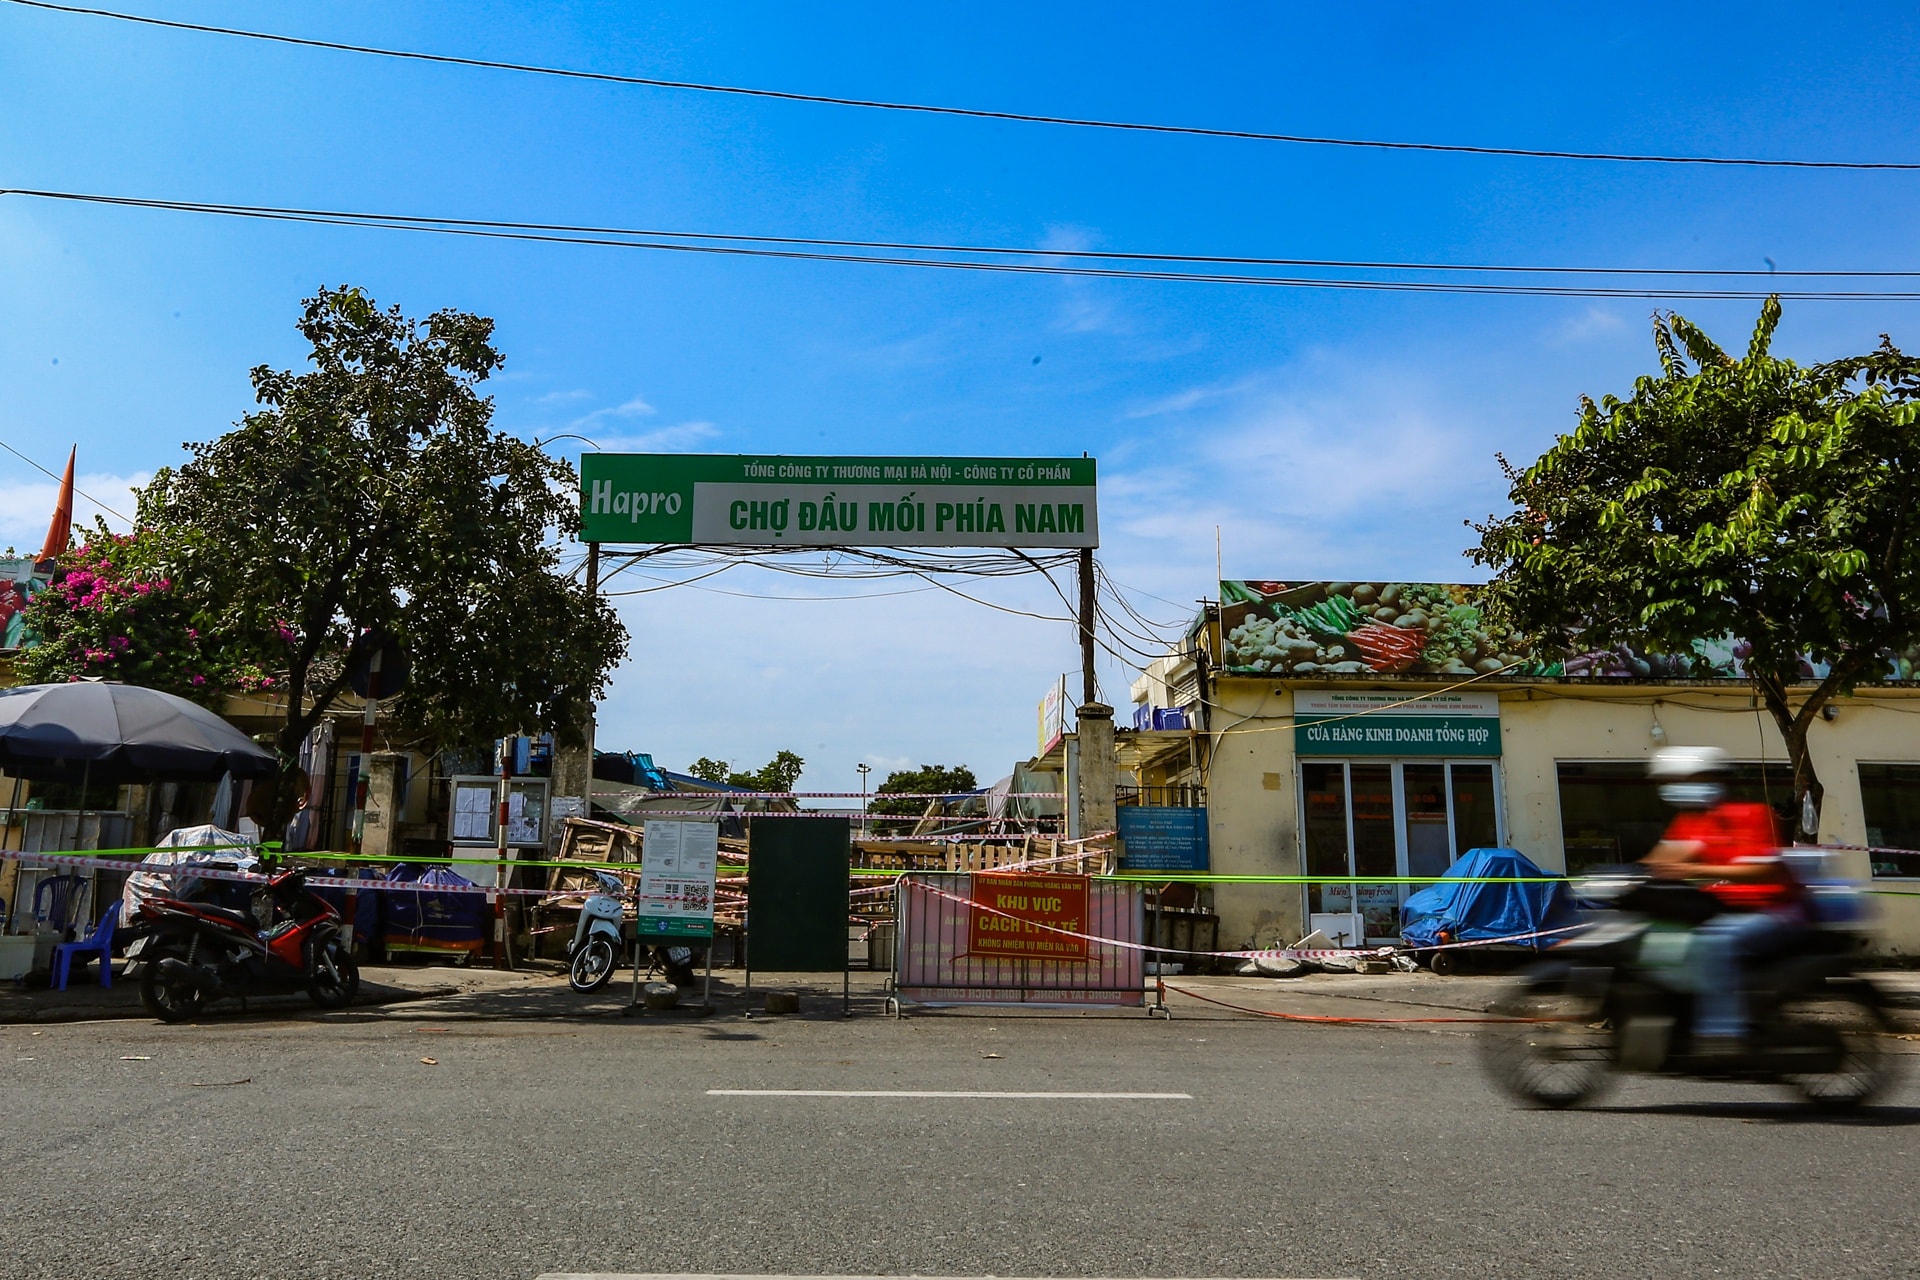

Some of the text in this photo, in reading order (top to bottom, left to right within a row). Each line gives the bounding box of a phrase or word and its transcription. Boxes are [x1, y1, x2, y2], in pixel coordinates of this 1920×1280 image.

[743, 459, 775, 478] TỔNG
[778, 462, 812, 478] CÔNG
[814, 465, 829, 478] TY
[832, 464, 881, 479] THƯƠNG
[884, 465, 907, 482] MẠI
[910, 464, 927, 480] HÀ
[930, 463, 952, 482] NỘI
[963, 463, 997, 480] CÔNG
[1000, 466, 1014, 480] TY
[1017, 462, 1035, 480] CỔ
[590, 479, 682, 523] Hapro
[729, 491, 1084, 537] CHỢ ĐẦU MỐI PHÍA NAM
[1307, 721, 1489, 746] CỬA HÀNG KINH DOANH TỔNG HỢP
[996, 894, 1062, 915] KHU VỰC
[979, 914, 1020, 933] CÁCH
[1060, 916, 1079, 934] TẾ
[978, 936, 1001, 948] KHÔNG
[1026, 940, 1036, 953] VỤ
[1055, 941, 1064, 952] RA
